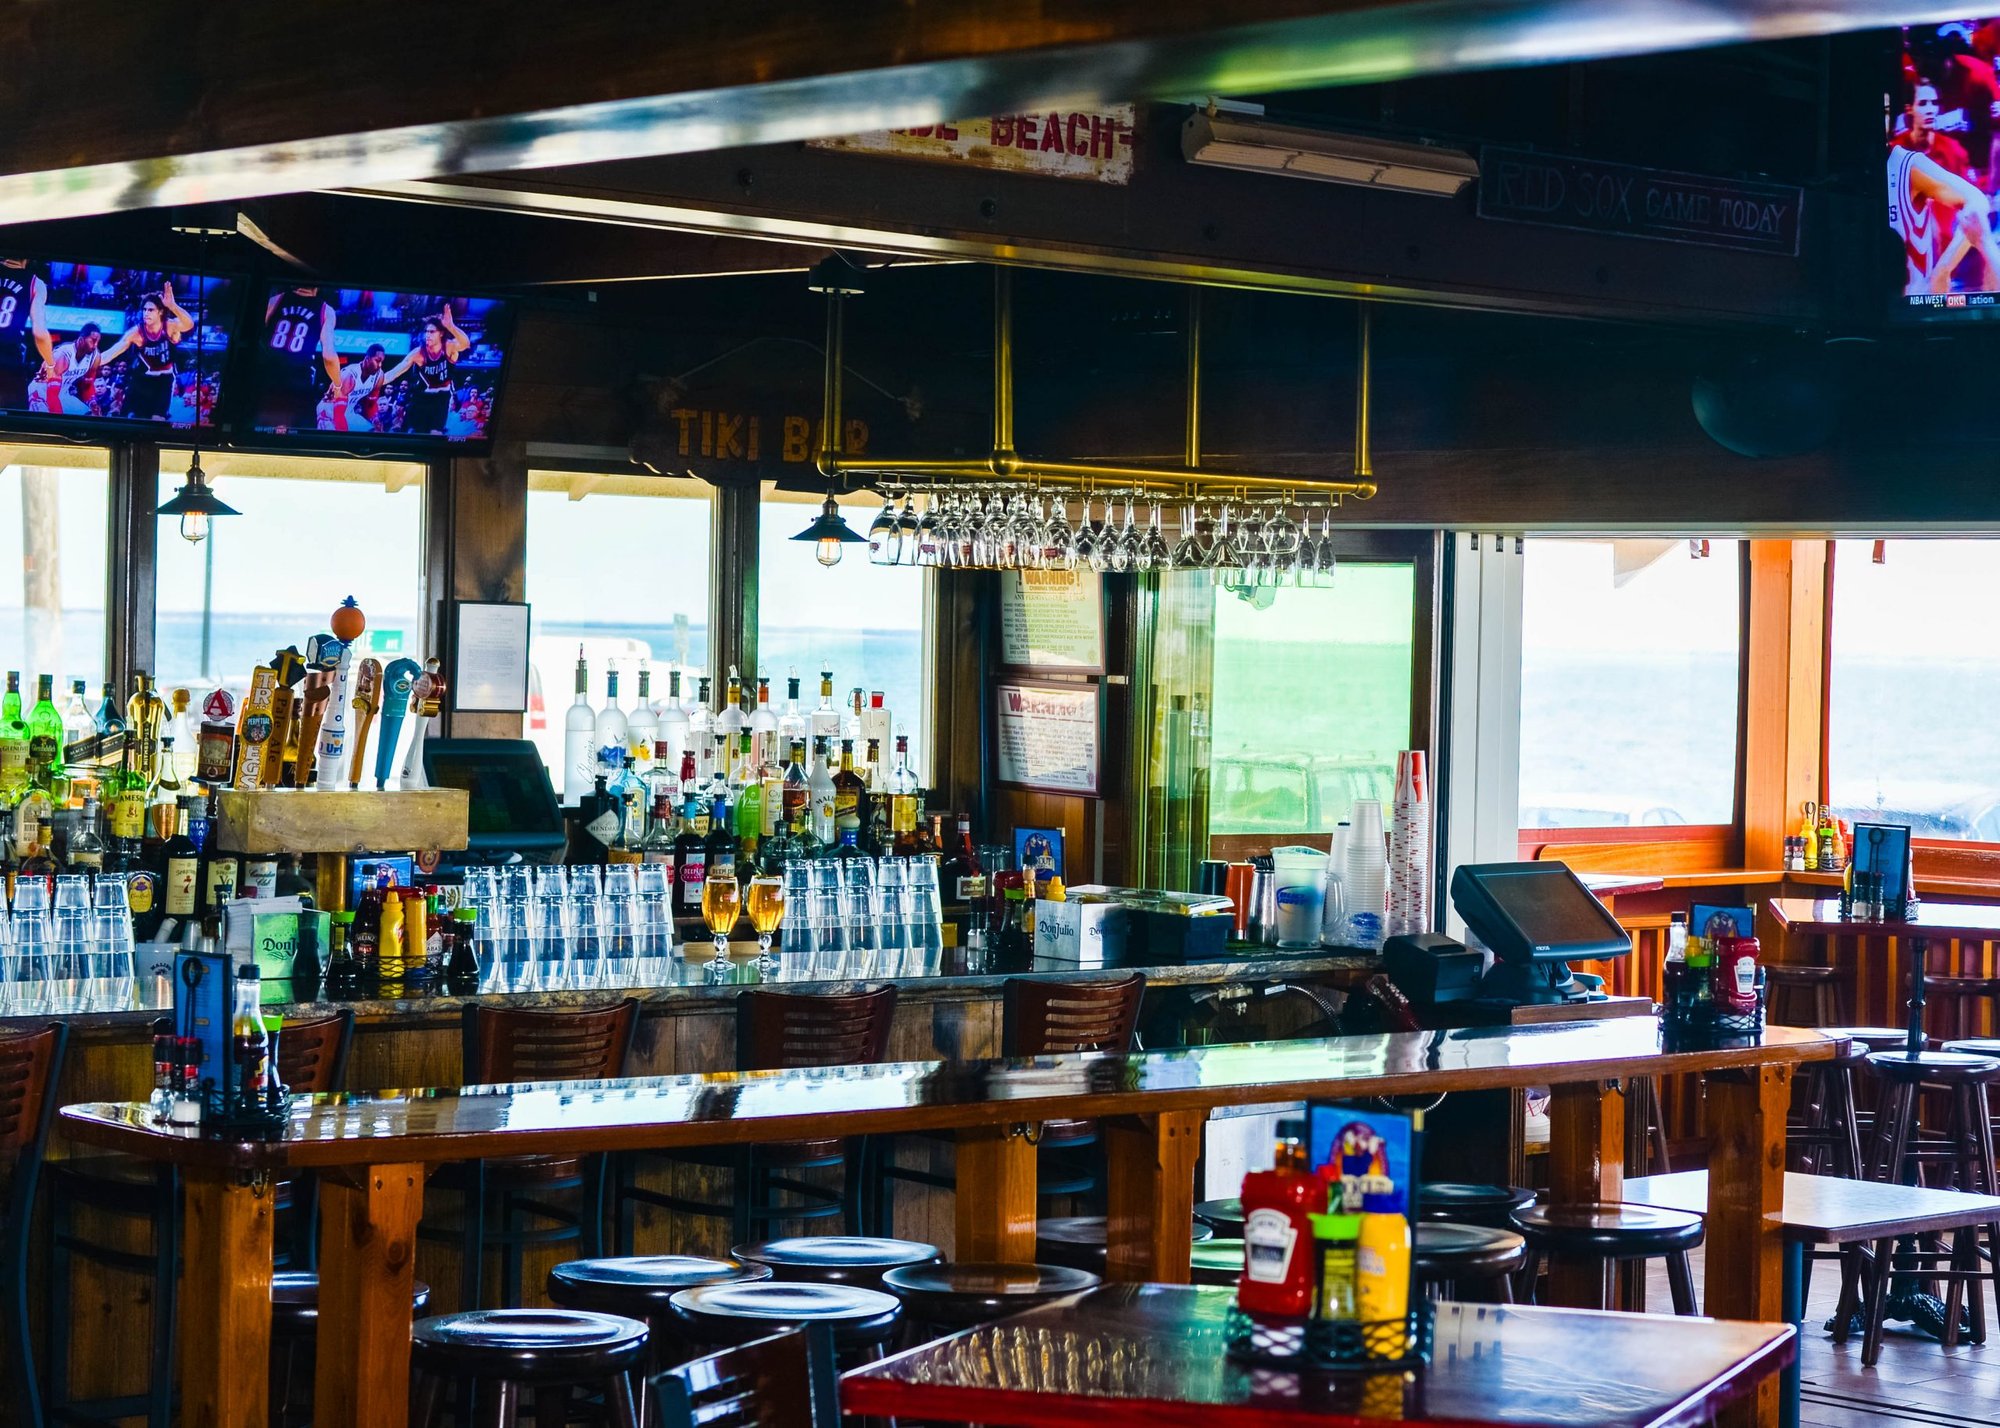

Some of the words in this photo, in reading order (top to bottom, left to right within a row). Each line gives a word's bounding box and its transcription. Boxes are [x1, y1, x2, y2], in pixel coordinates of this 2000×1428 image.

[1575, 173, 1635, 223] SOX
[1646, 187, 1710, 225] GAME
[1719, 198, 1788, 235] TODAY
[1910, 296, 1924, 305] NBA
[1925, 295, 1943, 304] WEST
[270, 318, 309, 353] 88
[670, 408, 760, 461] TIKI
[783, 415, 869, 463] BR
